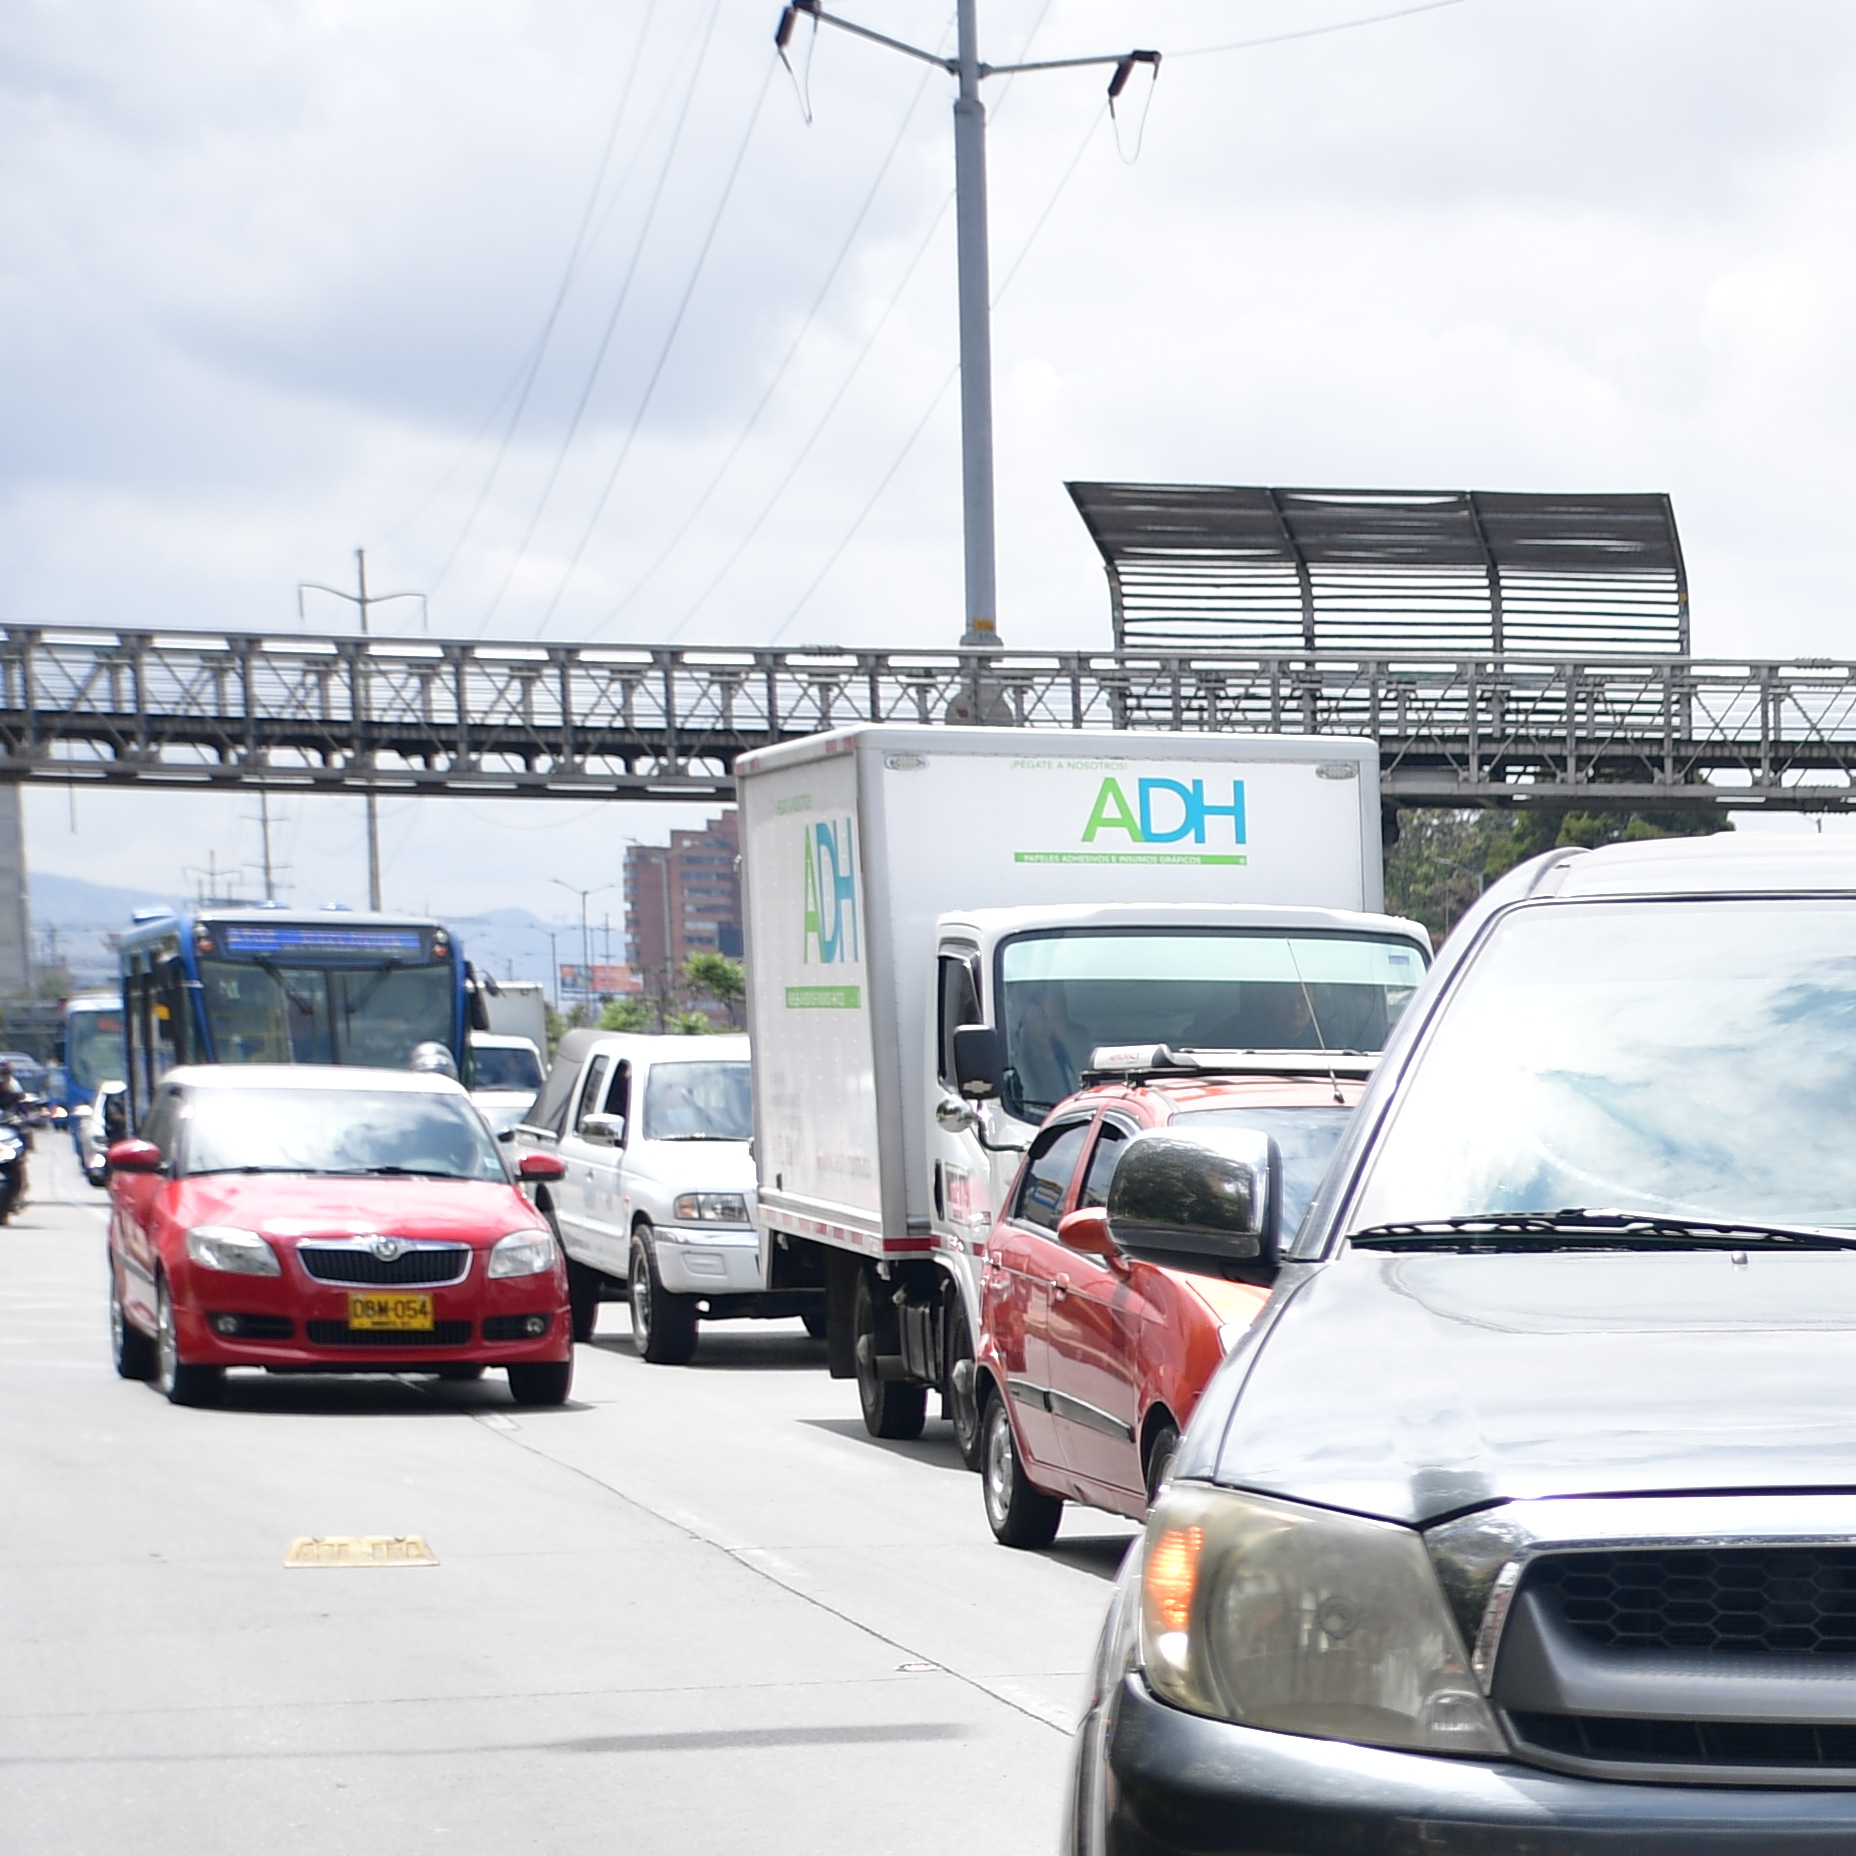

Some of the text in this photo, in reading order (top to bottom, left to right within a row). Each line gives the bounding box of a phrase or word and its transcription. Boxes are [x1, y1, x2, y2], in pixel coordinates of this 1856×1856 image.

[1057, 762, 1065, 770] A
[1081, 777, 1247, 844] ADH
[1024, 854, 1059, 863] PAPELES
[1062, 854, 1109, 864] ADHESIVOS
[1119, 855, 1157, 864] INSUMOS
[804, 817, 859, 964] ADH
